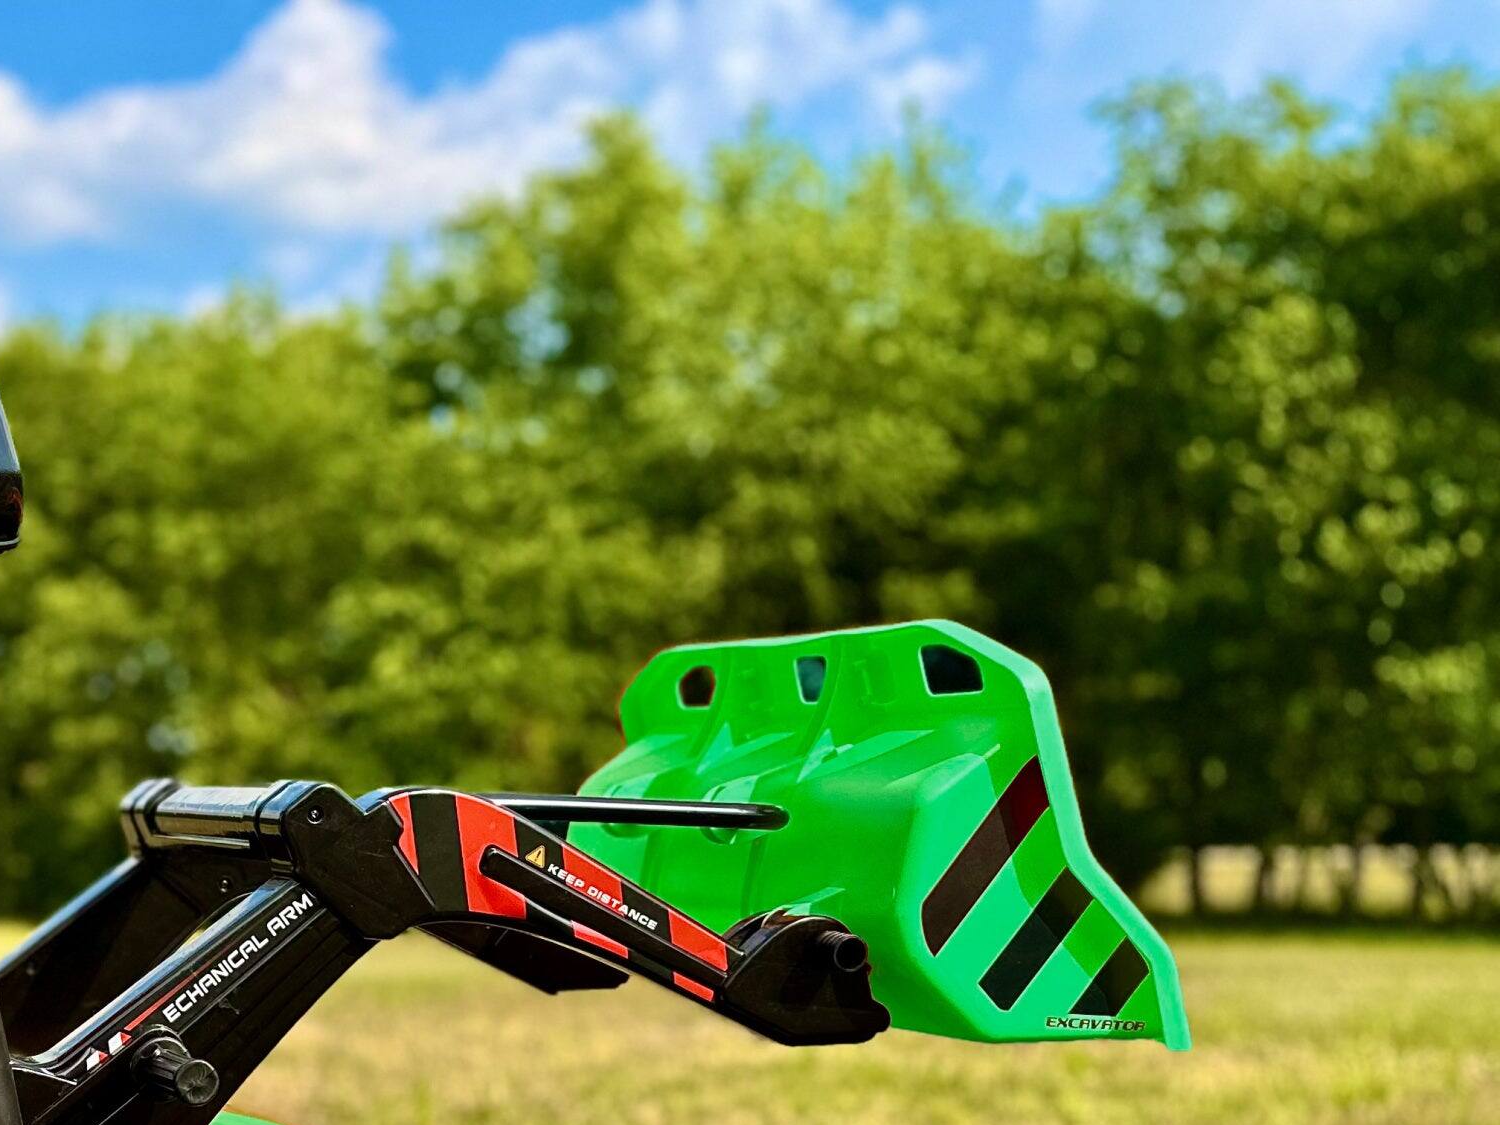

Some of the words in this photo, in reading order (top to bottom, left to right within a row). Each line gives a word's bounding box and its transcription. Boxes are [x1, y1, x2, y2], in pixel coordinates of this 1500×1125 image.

[547, 863, 585, 889] KEEP
[586, 886, 658, 930] DISTANCE
[162, 935, 269, 1023] ECHANICAL
[266, 893, 314, 937] ARM
[1046, 1016, 1146, 1031] EXCAVATOR
